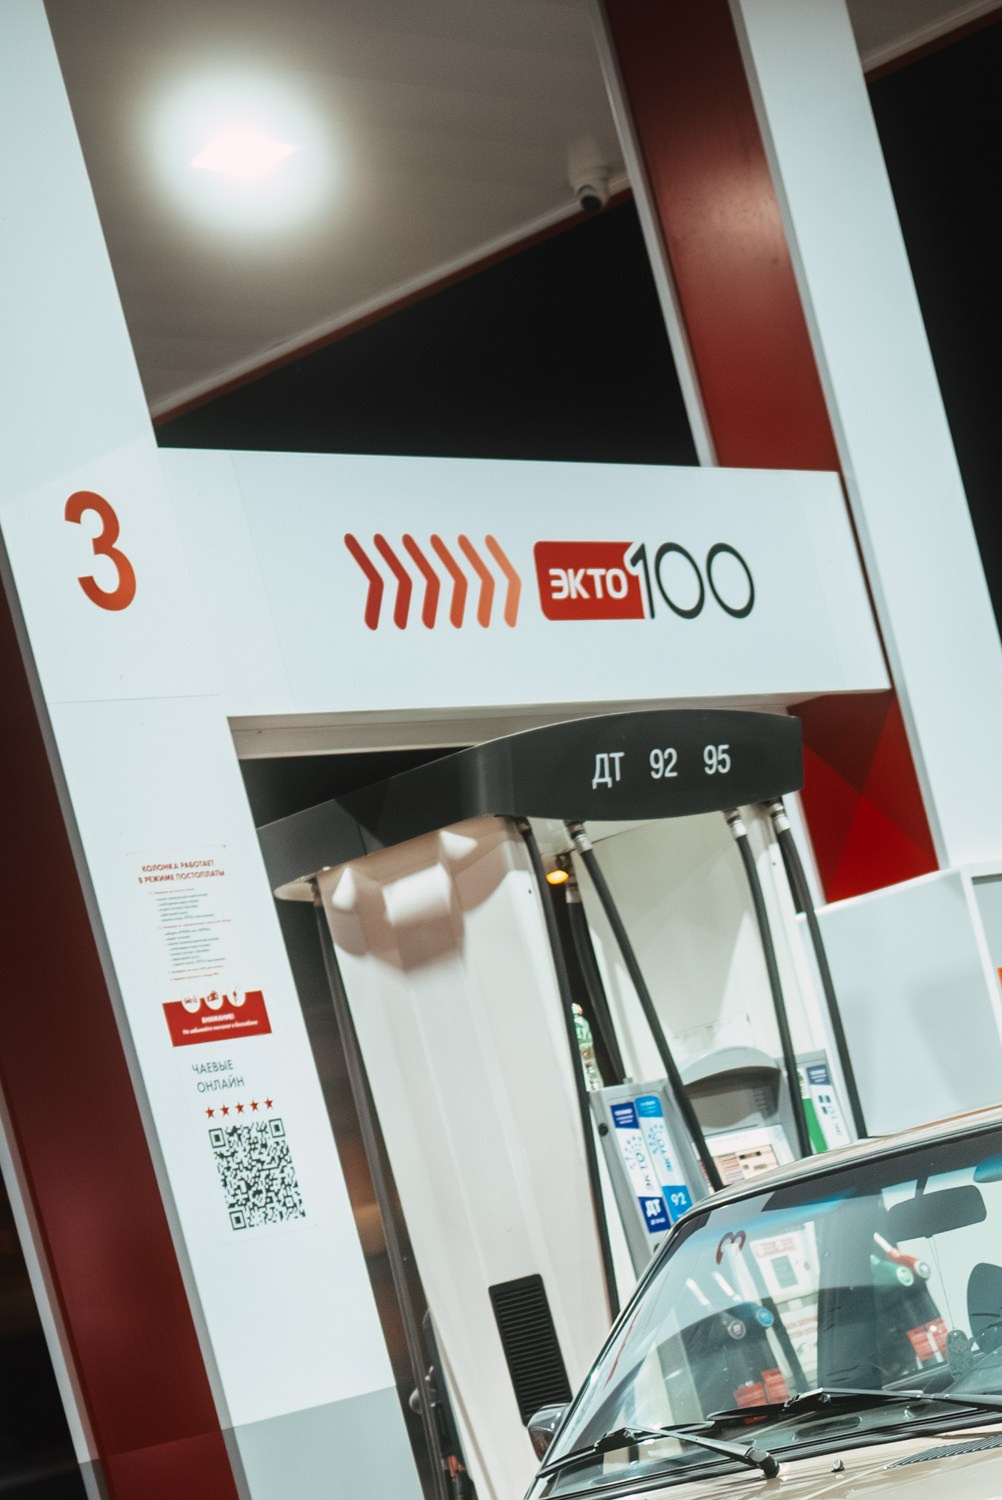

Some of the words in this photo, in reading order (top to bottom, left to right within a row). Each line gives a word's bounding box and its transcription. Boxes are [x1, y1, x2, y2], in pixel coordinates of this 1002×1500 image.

[63, 489, 138, 612] 3
[548, 567, 628, 600] ЭКТО
[630, 541, 755, 620] 100
[591, 751, 625, 789] ДТ
[649, 747, 678, 779] 92
[703, 744, 731, 775] 95
[191, 1059, 234, 1075] ЧАЕВЫЕ
[196, 1074, 245, 1094] ОНЛАЙН
[670, 1191, 687, 1207] 92
